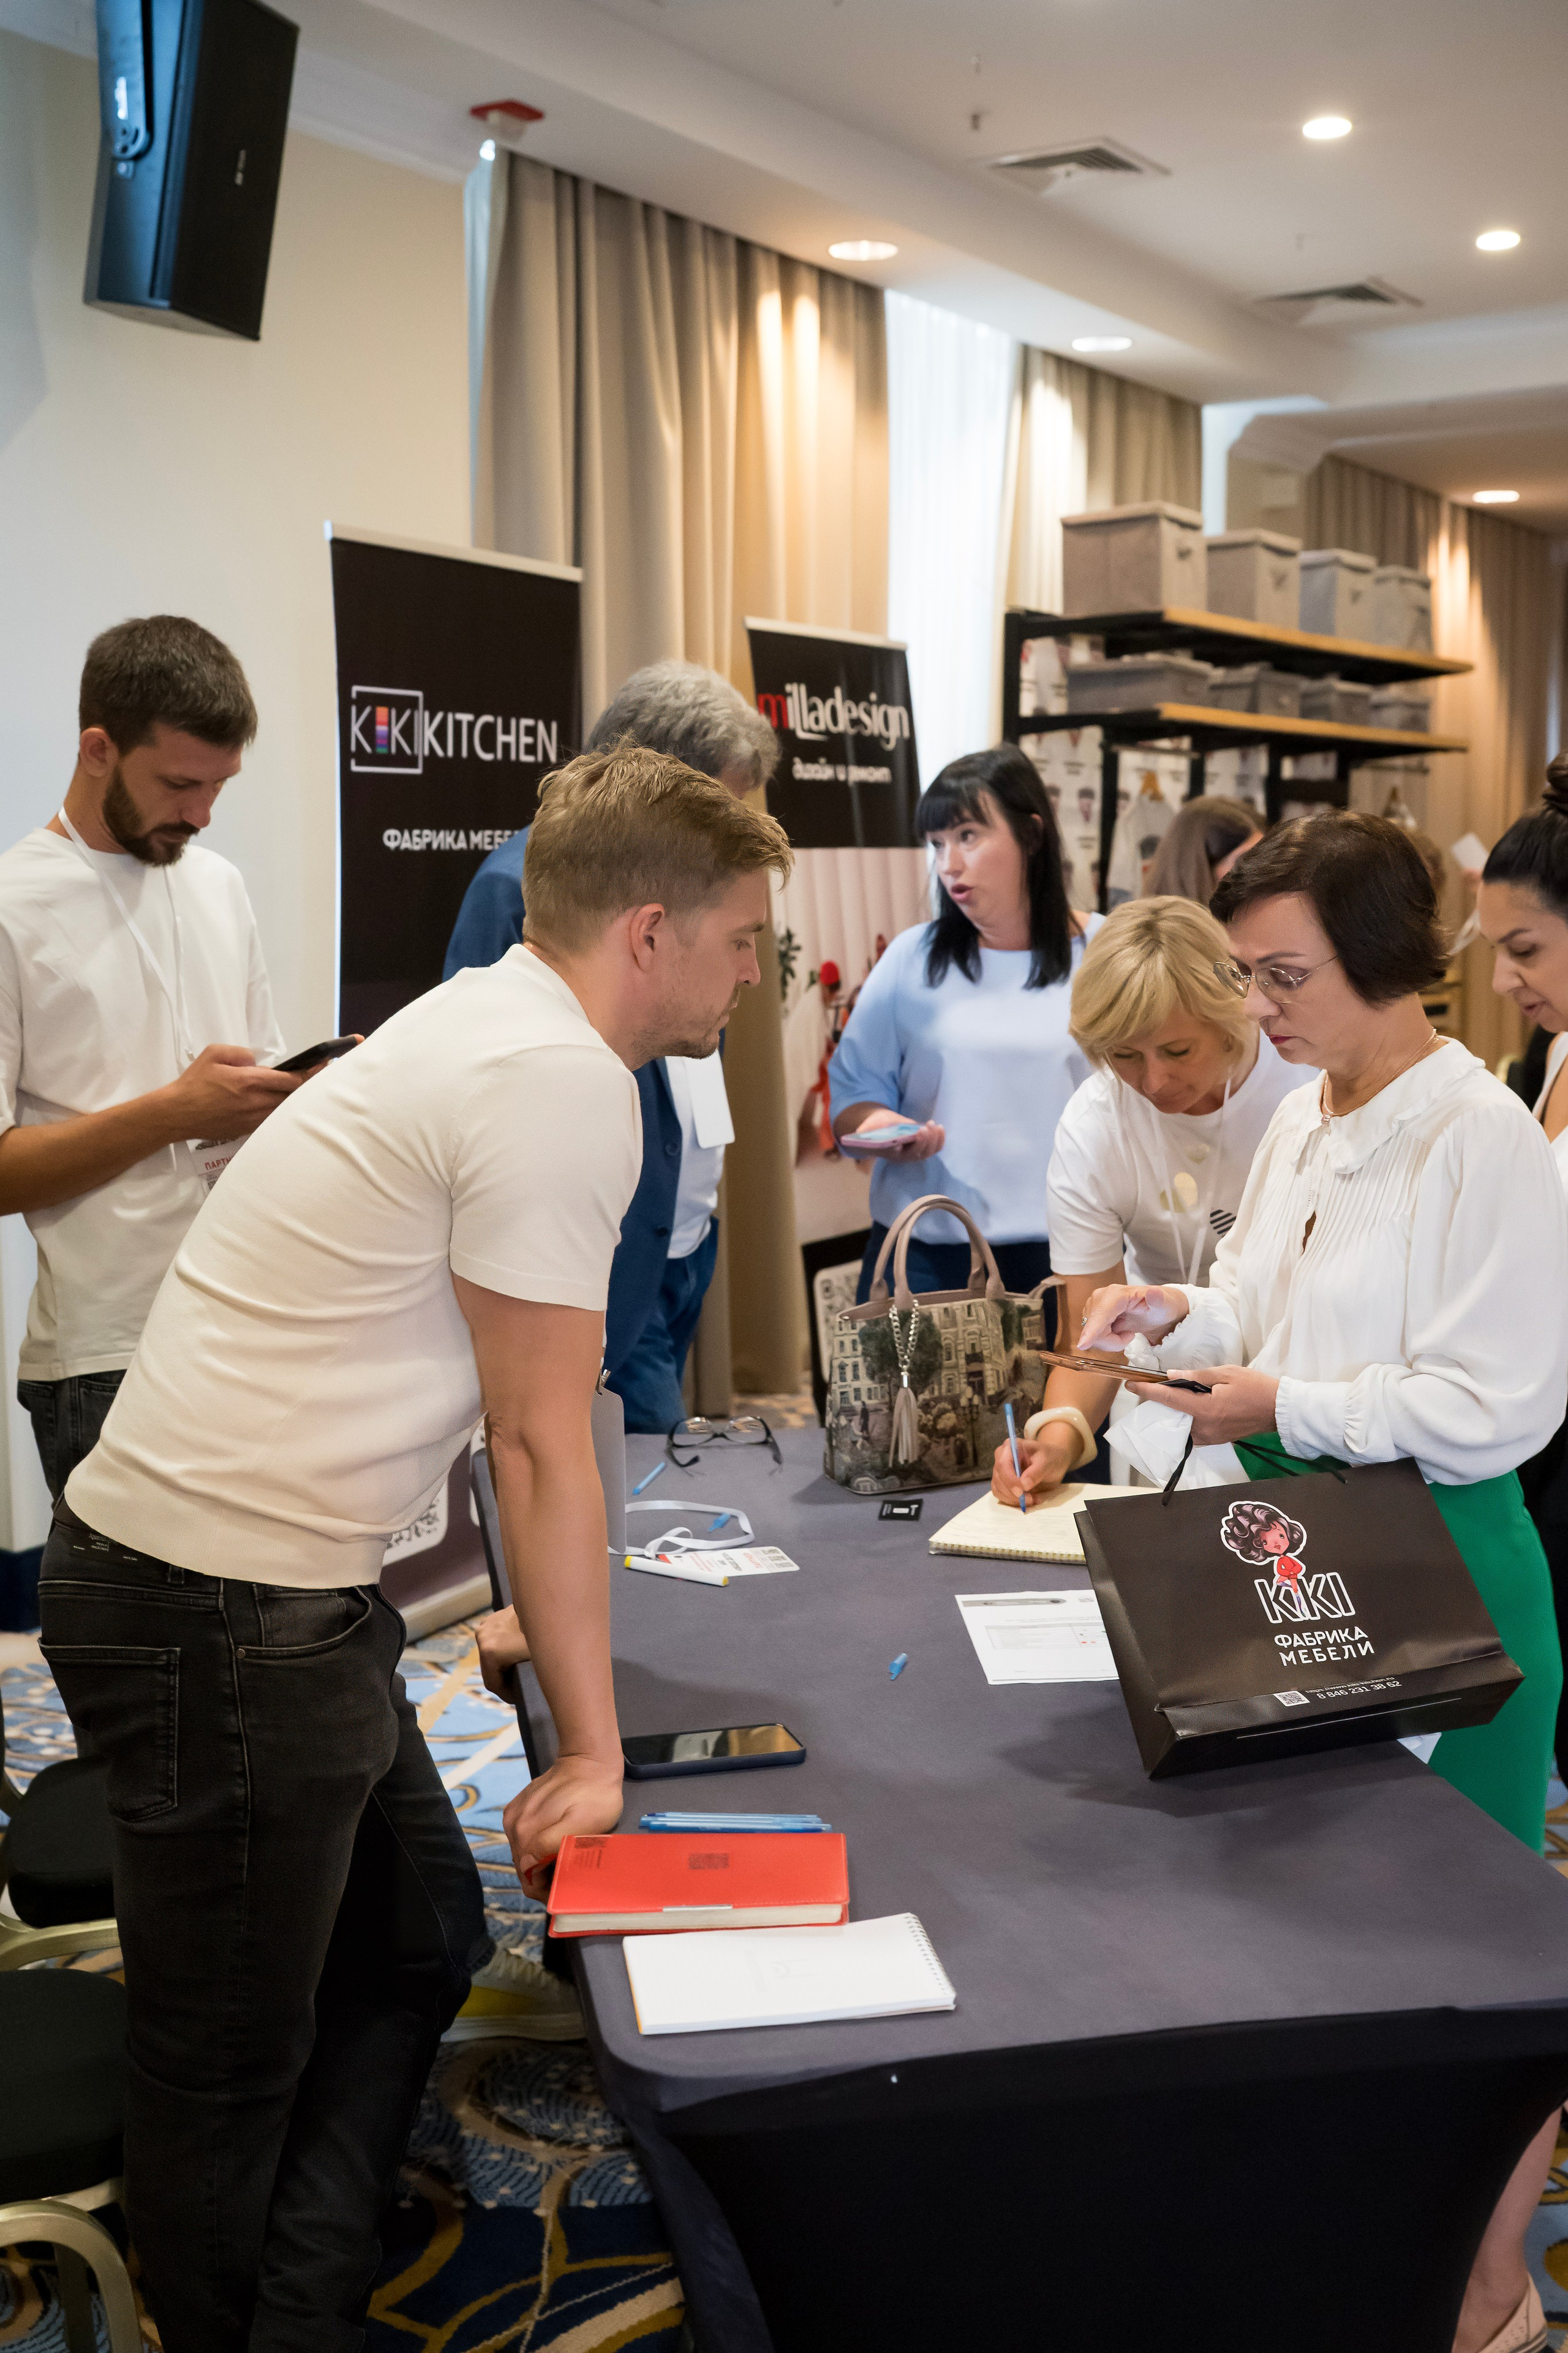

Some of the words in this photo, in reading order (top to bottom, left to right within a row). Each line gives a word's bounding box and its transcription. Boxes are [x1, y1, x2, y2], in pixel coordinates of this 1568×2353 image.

[423, 709, 559, 764] KITCHEN
[382, 828, 468, 851] ФАБРИКА
[1273, 1626, 1368, 1648] ФАБРИКА
[1278, 1641, 1374, 1666] МЕБЕЛИ
